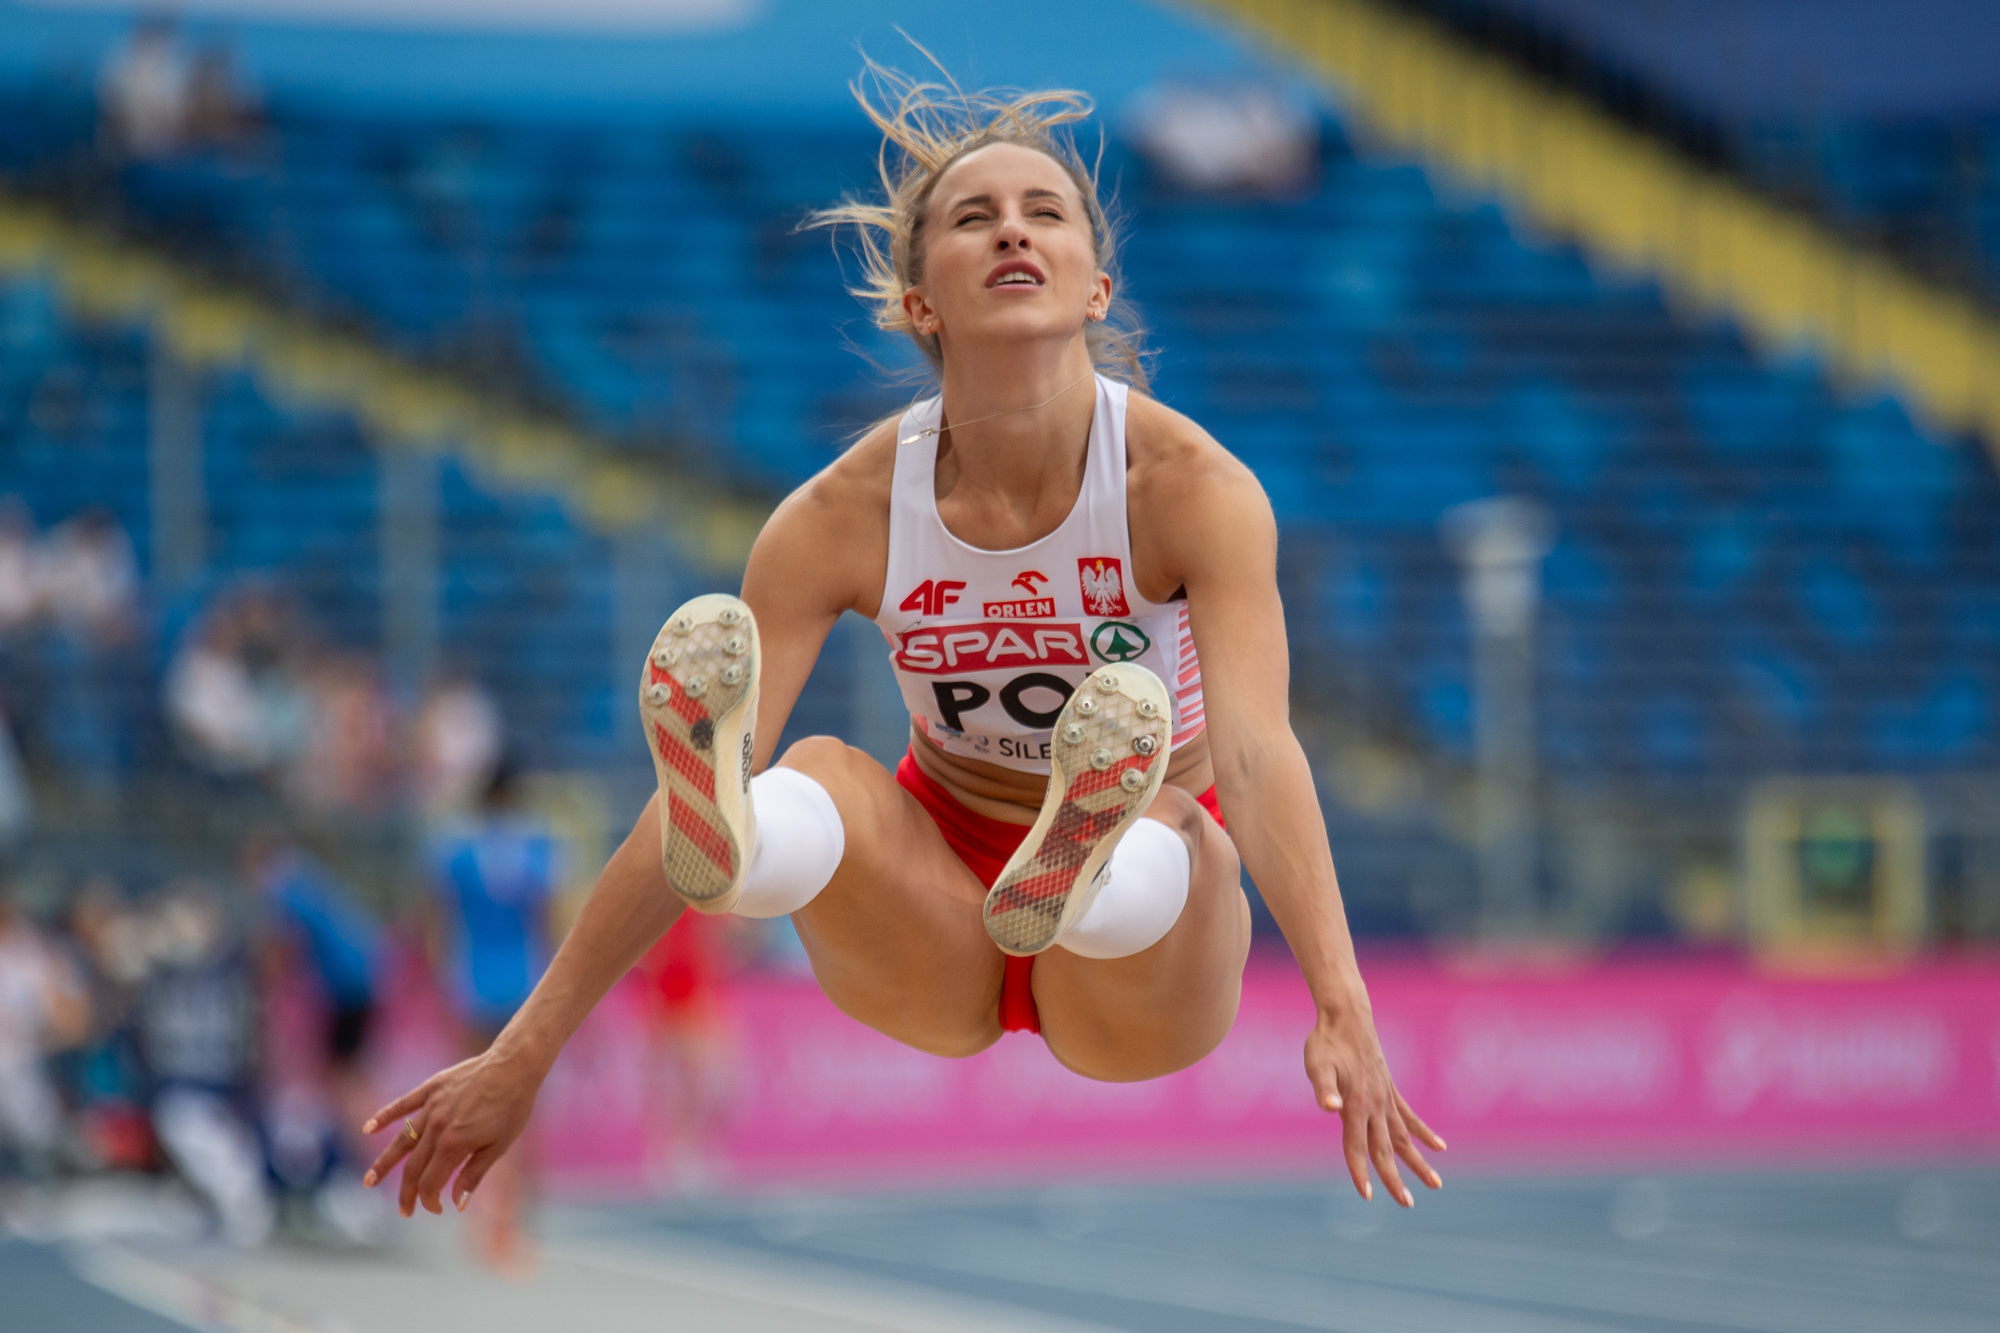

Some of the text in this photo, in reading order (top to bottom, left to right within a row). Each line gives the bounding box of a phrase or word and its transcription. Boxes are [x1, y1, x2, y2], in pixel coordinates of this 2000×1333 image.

[899, 579, 967, 616] 4F
[987, 601, 1051, 618] ORLEN
[901, 628, 1083, 670] SPAR
[931, 672, 1091, 732] PO
